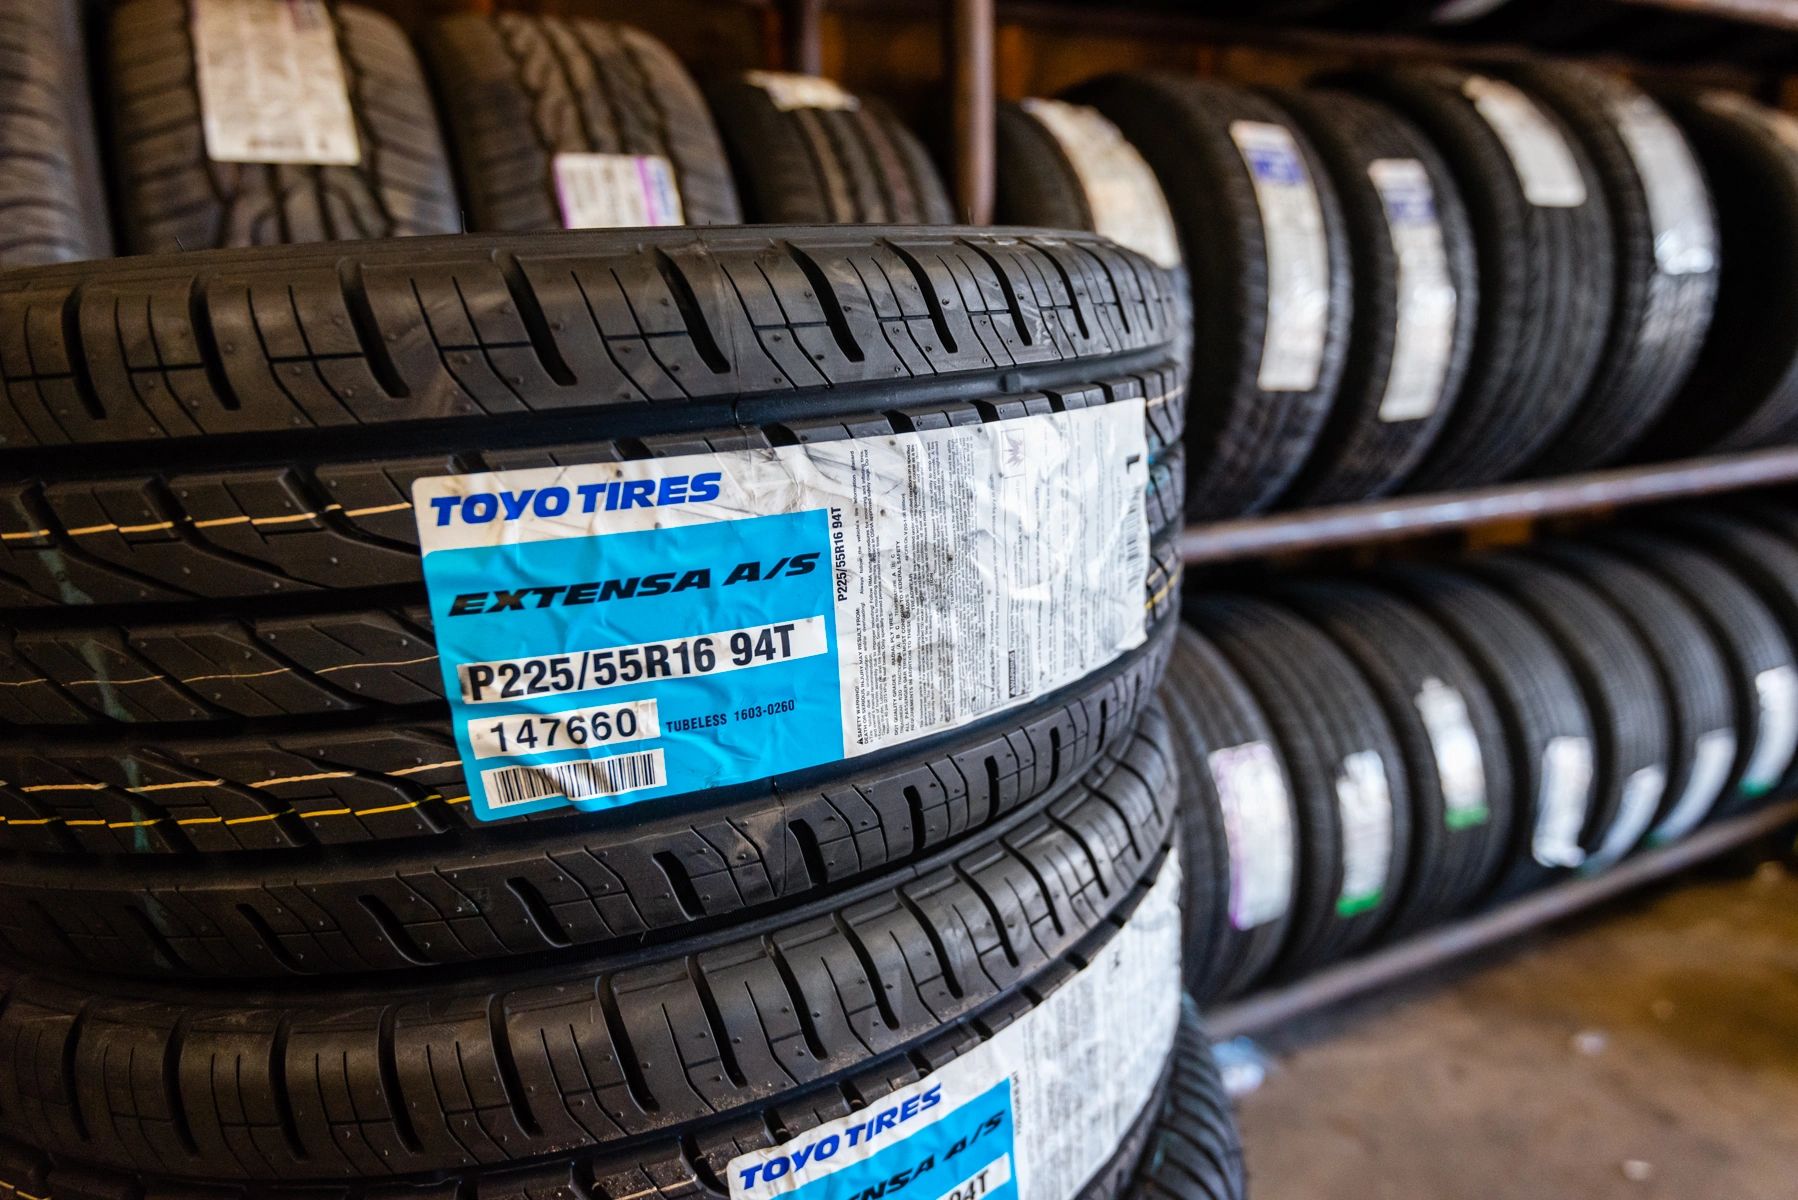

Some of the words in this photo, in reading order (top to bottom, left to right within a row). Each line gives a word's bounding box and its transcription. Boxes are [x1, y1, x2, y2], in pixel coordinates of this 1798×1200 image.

[430, 486, 570, 527] TOYO
[577, 472, 722, 513] TIRES
[831, 507, 842, 529] 94T
[448, 568, 711, 617] EXTENSA
[722, 552, 820, 586] A/S
[833, 531, 848, 602] P225/55R16
[469, 638, 716, 701] P225/55R16
[730, 623, 795, 666] 94T
[491, 708, 637, 752] 147660
[666, 713, 727, 733] TUBELESS
[734, 699, 795, 721] 1603-0260
[739, 1134, 840, 1190] TOYO
[844, 1082, 942, 1145] TIRES
[943, 1110, 1005, 1161] A/S
